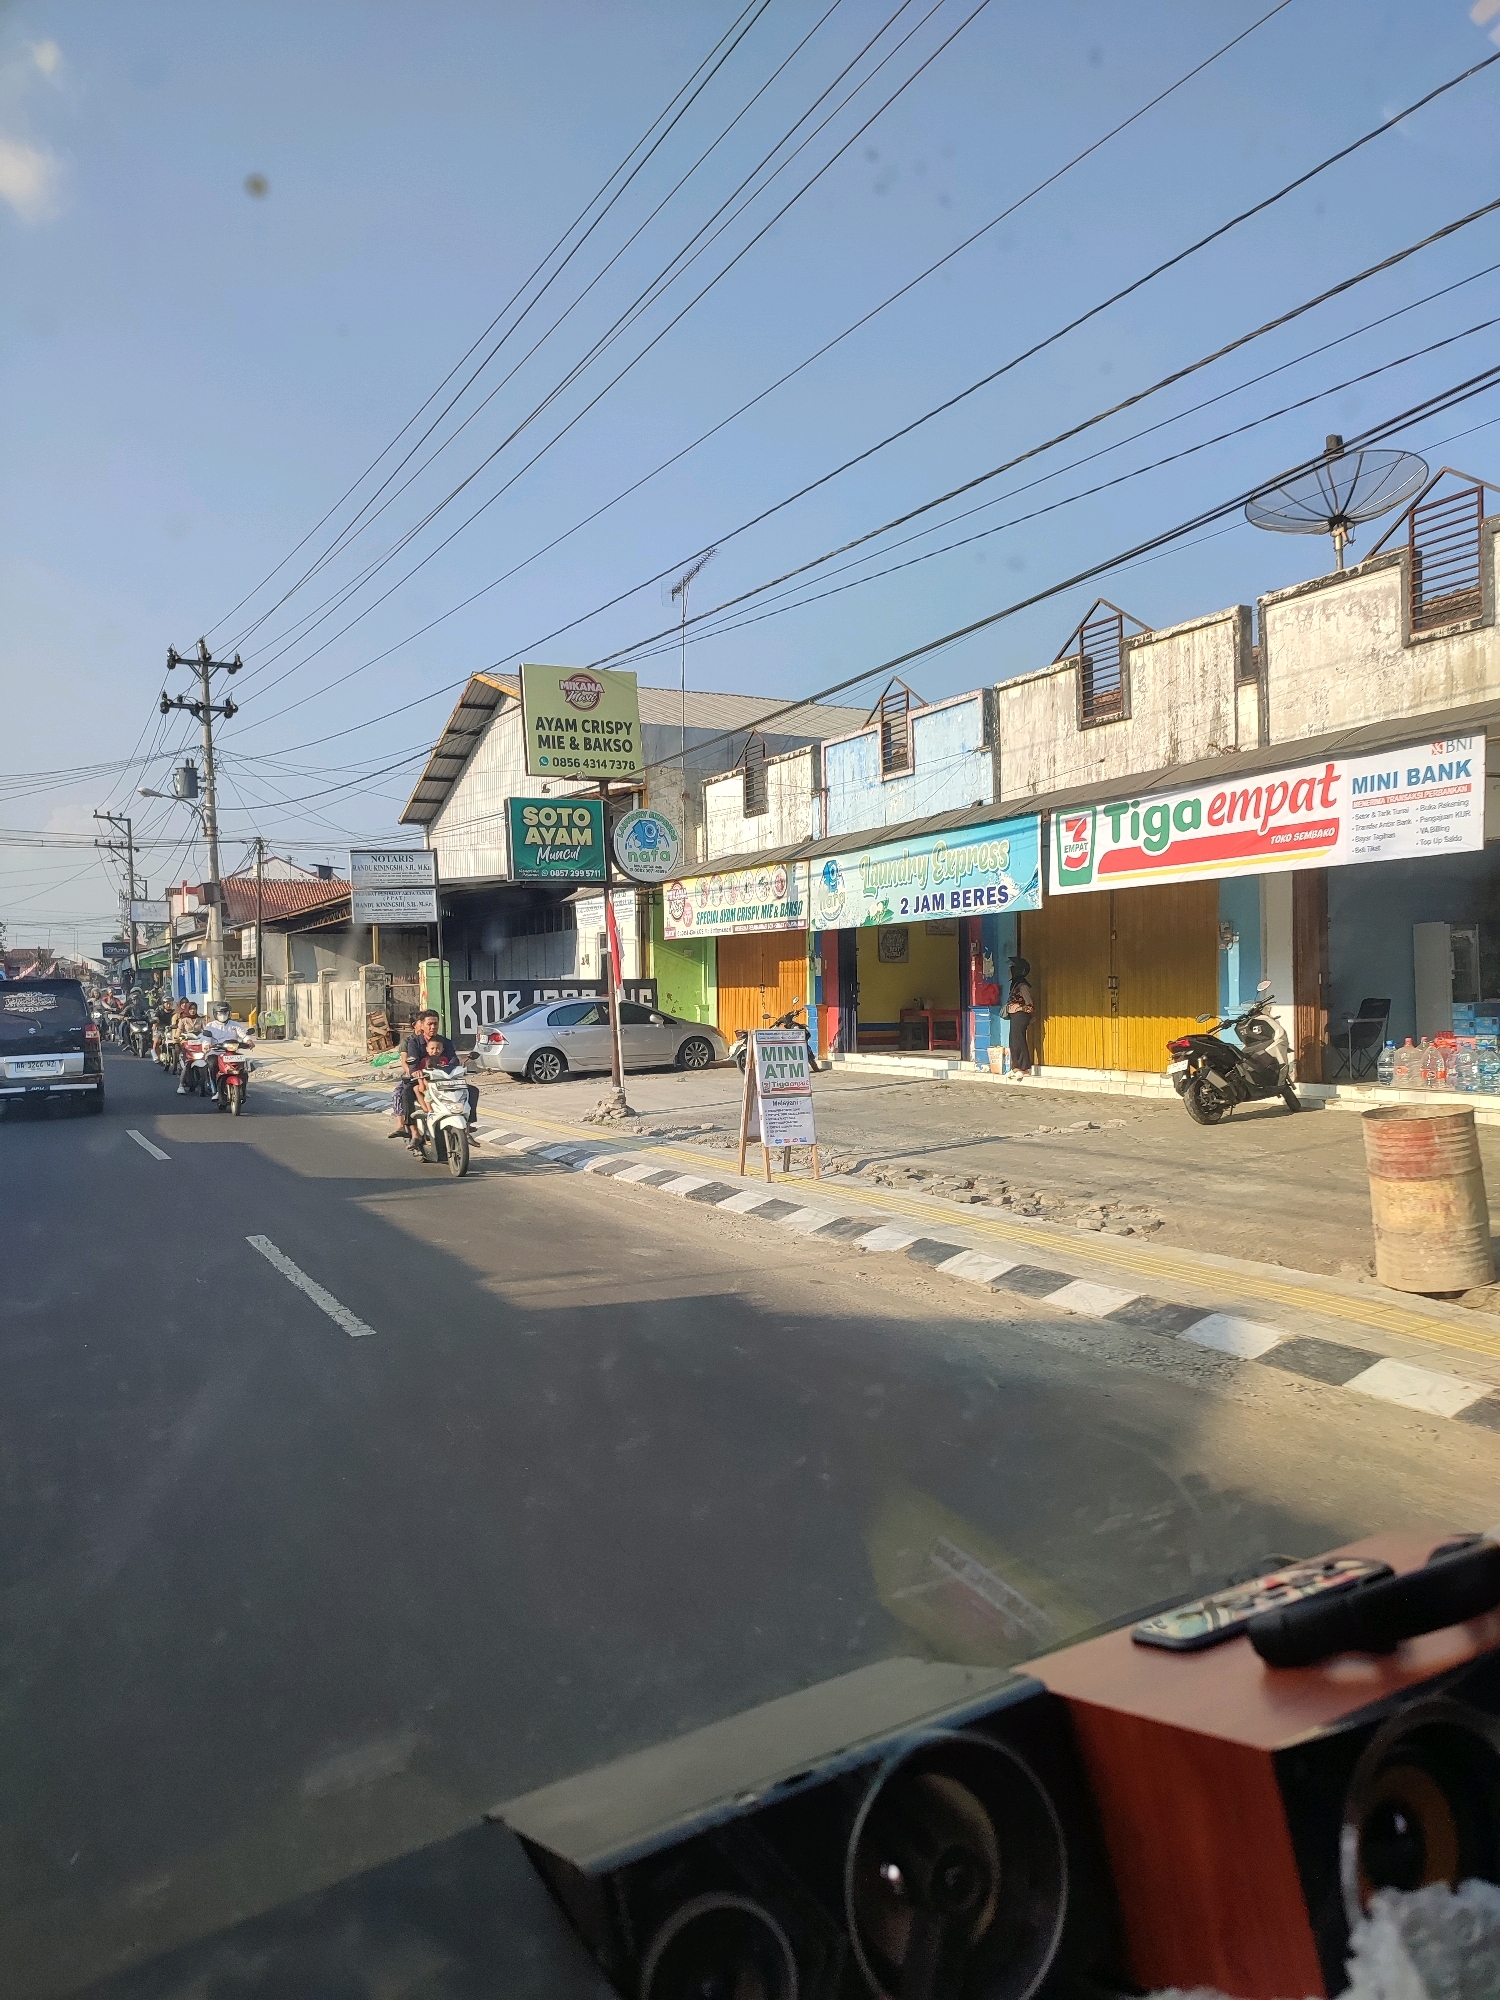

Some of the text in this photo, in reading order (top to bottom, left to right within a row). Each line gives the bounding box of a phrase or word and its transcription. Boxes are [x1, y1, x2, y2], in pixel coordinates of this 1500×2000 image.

[560, 680, 604, 693] MIKANA
[535, 716, 633, 735] AYAM CRISPY
[537, 735, 633, 753] MIE & BAKSO
[1445, 736, 1473, 754] BNI
[552, 757, 635, 770] 0856 4314 7378
[1352, 759, 1472, 795] MINI BANK
[1353, 785, 1468, 808] MENERIMA TRANSAKSI PERBANKAN
[523, 806, 591, 827] SOTO
[1103, 763, 1341, 852] Tiga empat
[524, 827, 592, 846] AYAM
[1270, 826, 1335, 845] TOKO SEMBAKO
[536, 846, 581, 865] Muncul
[627, 846, 670, 862] nafa
[1064, 841, 1088, 854] EMPAT
[371, 855, 414, 863] NOTARIS
[550, 869, 601, 877] 0857 299 5711
[859, 840, 1010, 898] Laundry Express
[900, 885, 1009, 915] 2 JAM BERES
[696, 910, 718, 926] SPECIAL
[719, 908, 736, 923] AYAM
[761, 903, 774, 920] MIE
[780, 900, 803, 917] BAKSO
[761, 1046, 804, 1062] MINI
[765, 1063, 805, 1079] ATM
